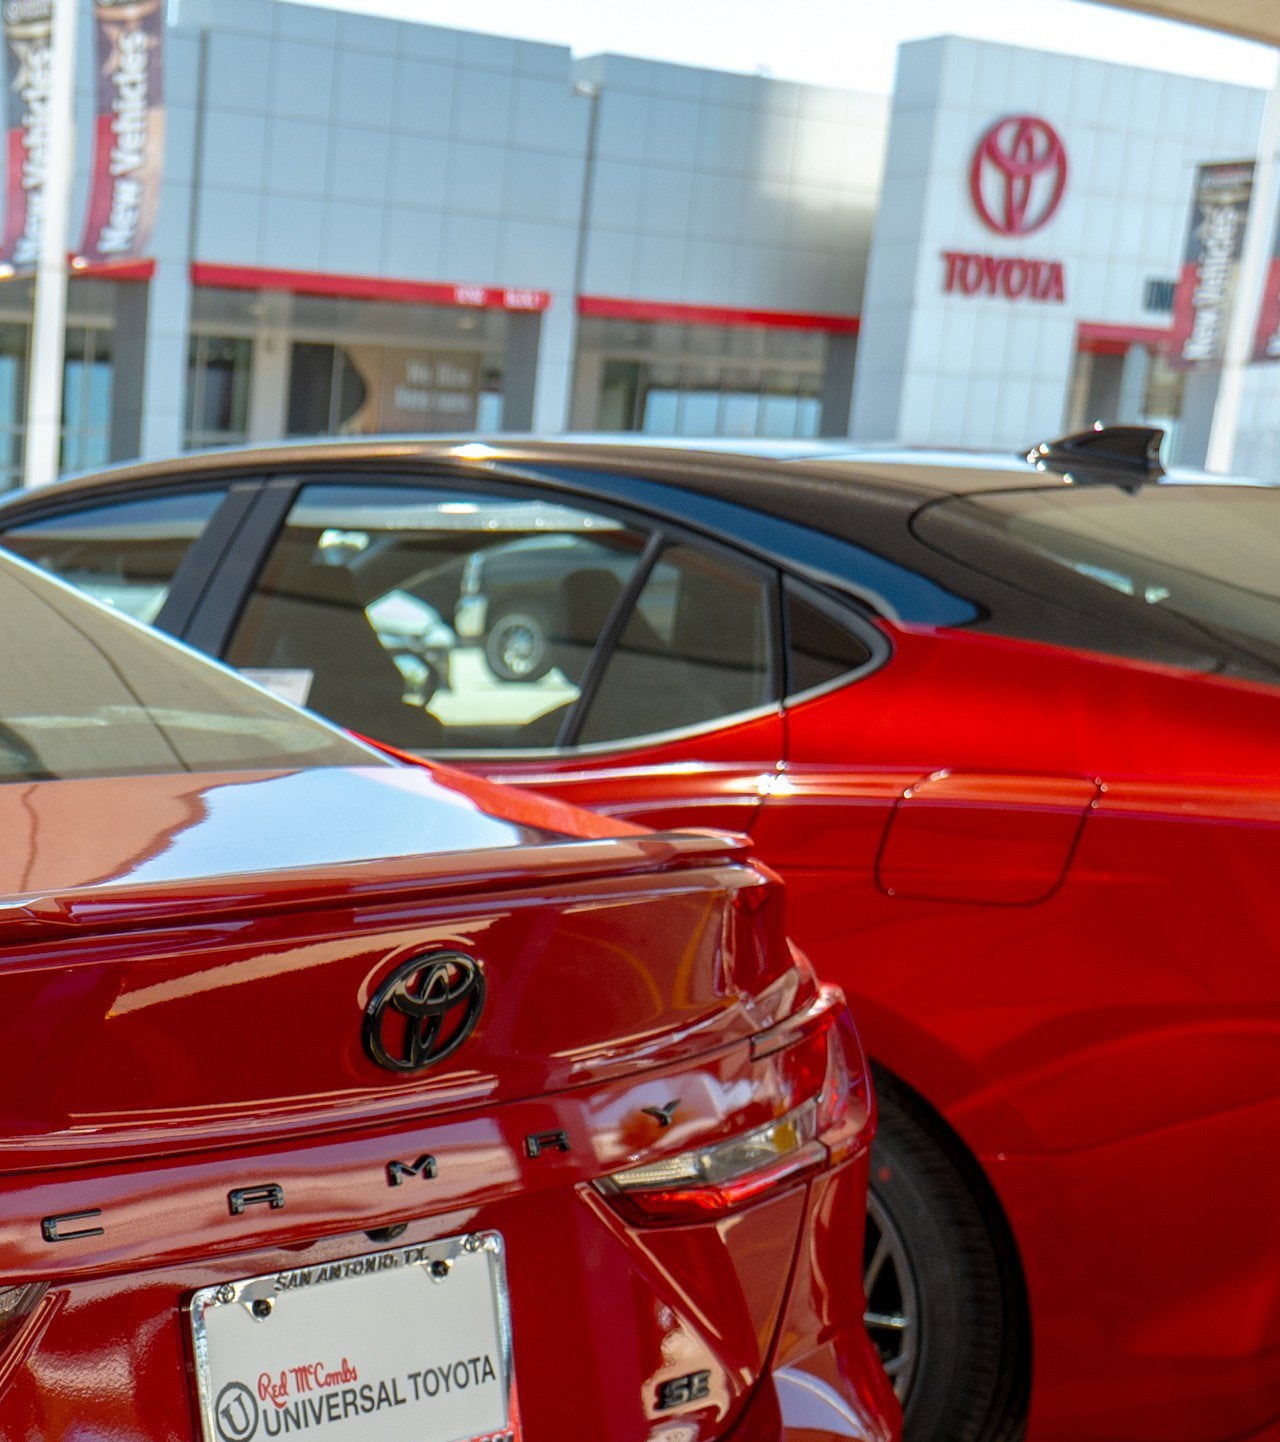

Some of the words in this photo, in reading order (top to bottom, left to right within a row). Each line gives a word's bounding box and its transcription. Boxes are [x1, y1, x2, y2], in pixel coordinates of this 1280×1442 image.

[108, 29, 150, 177] Vehicles
[96, 179, 142, 254] New
[941, 250, 1066, 304] TOYOTA
[40, 1099, 682, 1243] CAMRY
[273, 1270, 312, 1292] SAN
[257, 1371, 290, 1409] Red
[290, 1357, 358, 1394] McCombs
[261, 1376, 407, 1437] UNIVERSAL
[407, 1354, 497, 1401] TOYOTA
[653, 1369, 712, 1412] SE
